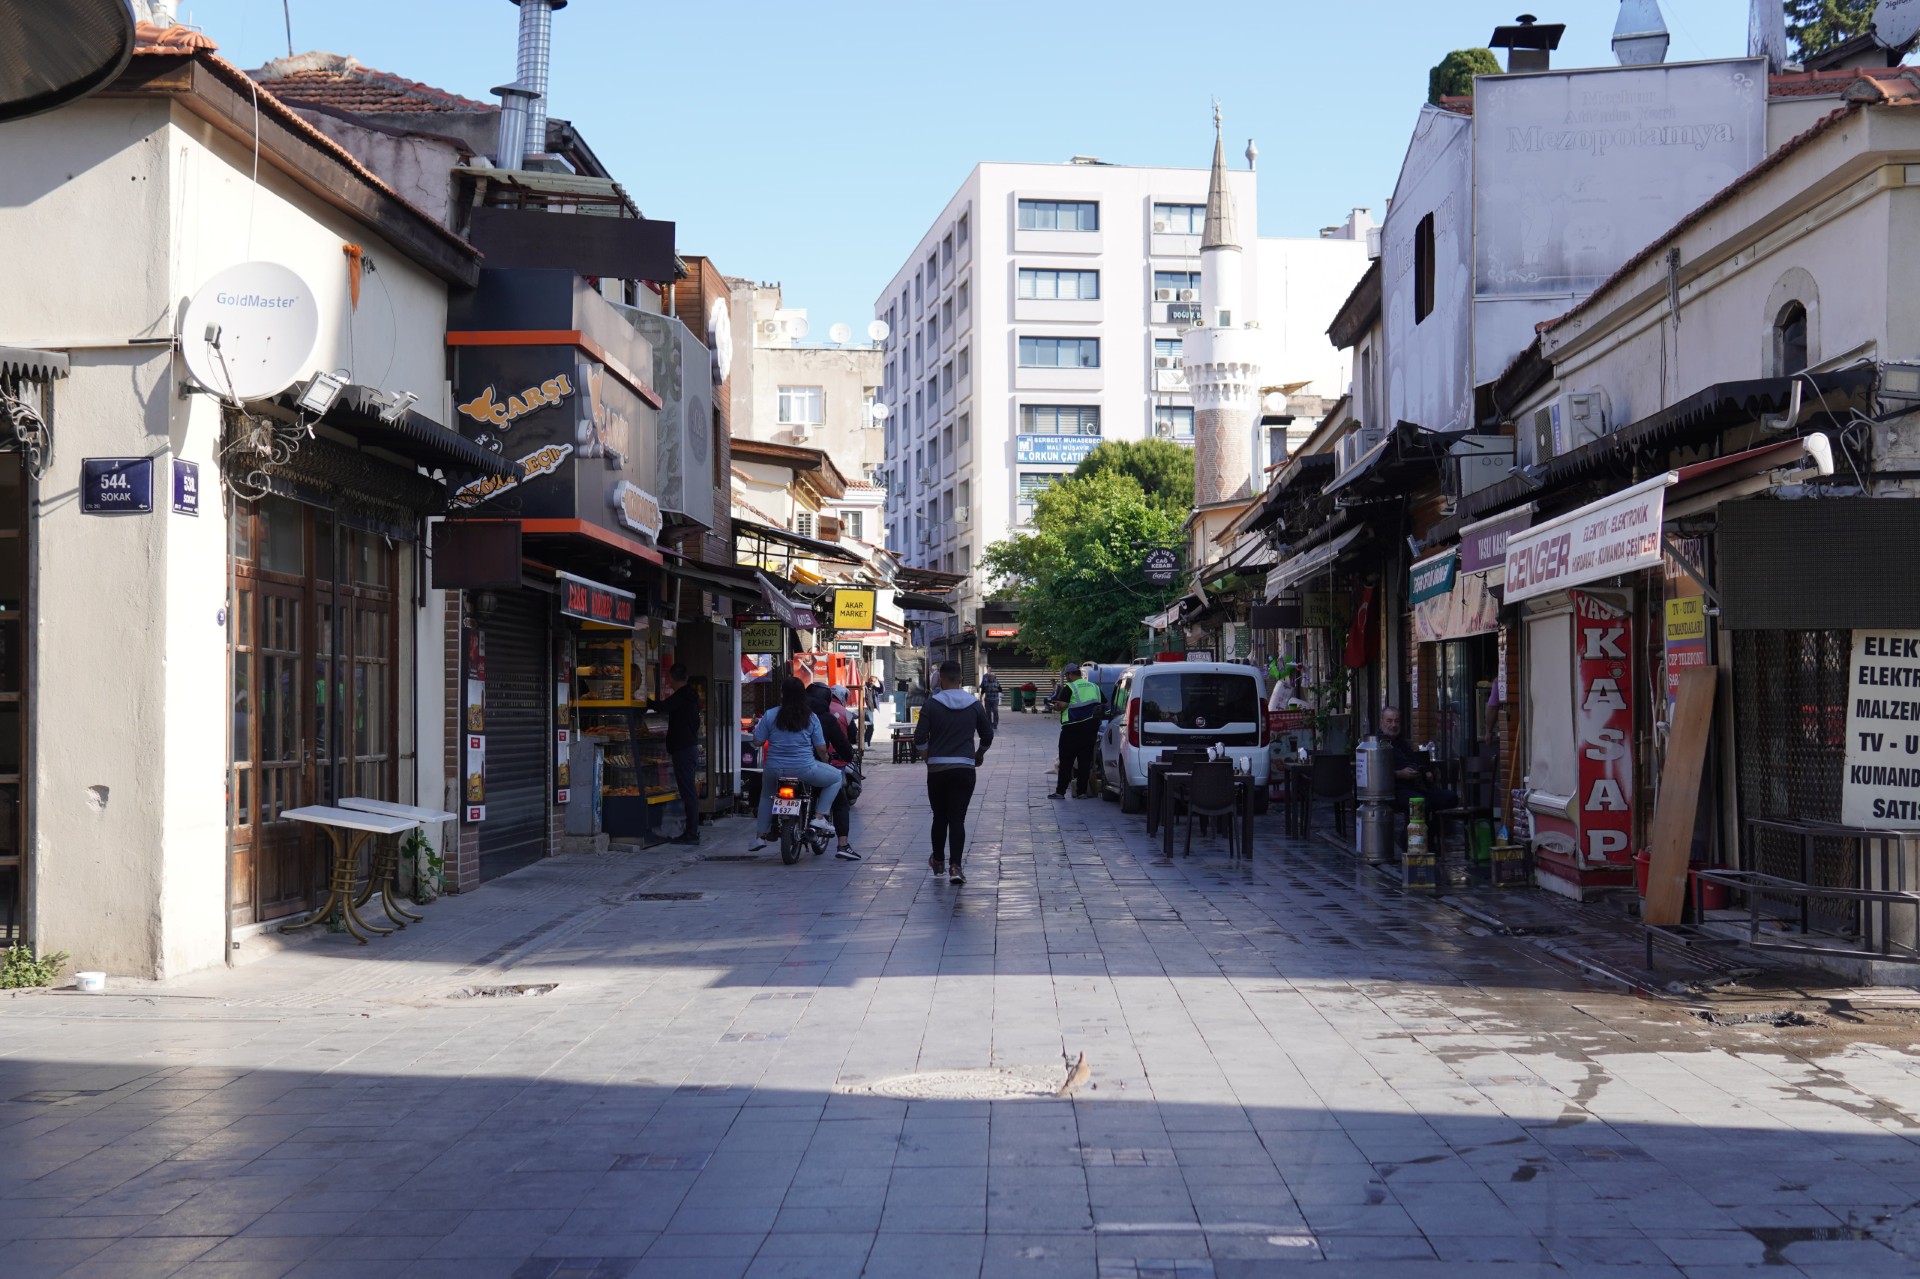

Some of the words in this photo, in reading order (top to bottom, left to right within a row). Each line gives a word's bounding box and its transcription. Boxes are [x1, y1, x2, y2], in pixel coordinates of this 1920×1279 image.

[1506, 122, 1735, 157] Mezopotamya
[216, 292, 295, 308] GoldMaster
[488, 374, 572, 430] ÇARŞI
[1018, 452, 1027, 460] M.
[1028, 452, 1058, 460] ORKUN
[100, 473, 131, 489] 544.
[100, 493, 131, 502] SOKAK
[1583, 515, 1609, 543] ELEKTRİK
[1611, 502, 1649, 533] ELEKTRONİK
[1161, 550, 1176, 562] USTA
[1572, 551, 1596, 573] HIRDAVAT
[1598, 543, 1625, 565] KUMANDA
[1626, 527, 1659, 562] ÇEŞİTLERİ
[1507, 532, 1571, 593] CENGER
[1672, 603, 1679, 616] TV
[1683, 601, 1697, 614] UYDU
[744, 628, 778, 636] AKARSU
[1667, 620, 1703, 636] KUMANDALARI
[1864, 637, 1920, 658] ELEK
[1668, 653, 1677, 666] CEP
[1668, 673, 1681, 690] ŞAR
[1583, 627, 1629, 862] KASAP
[1859, 732, 1884, 752] TV
